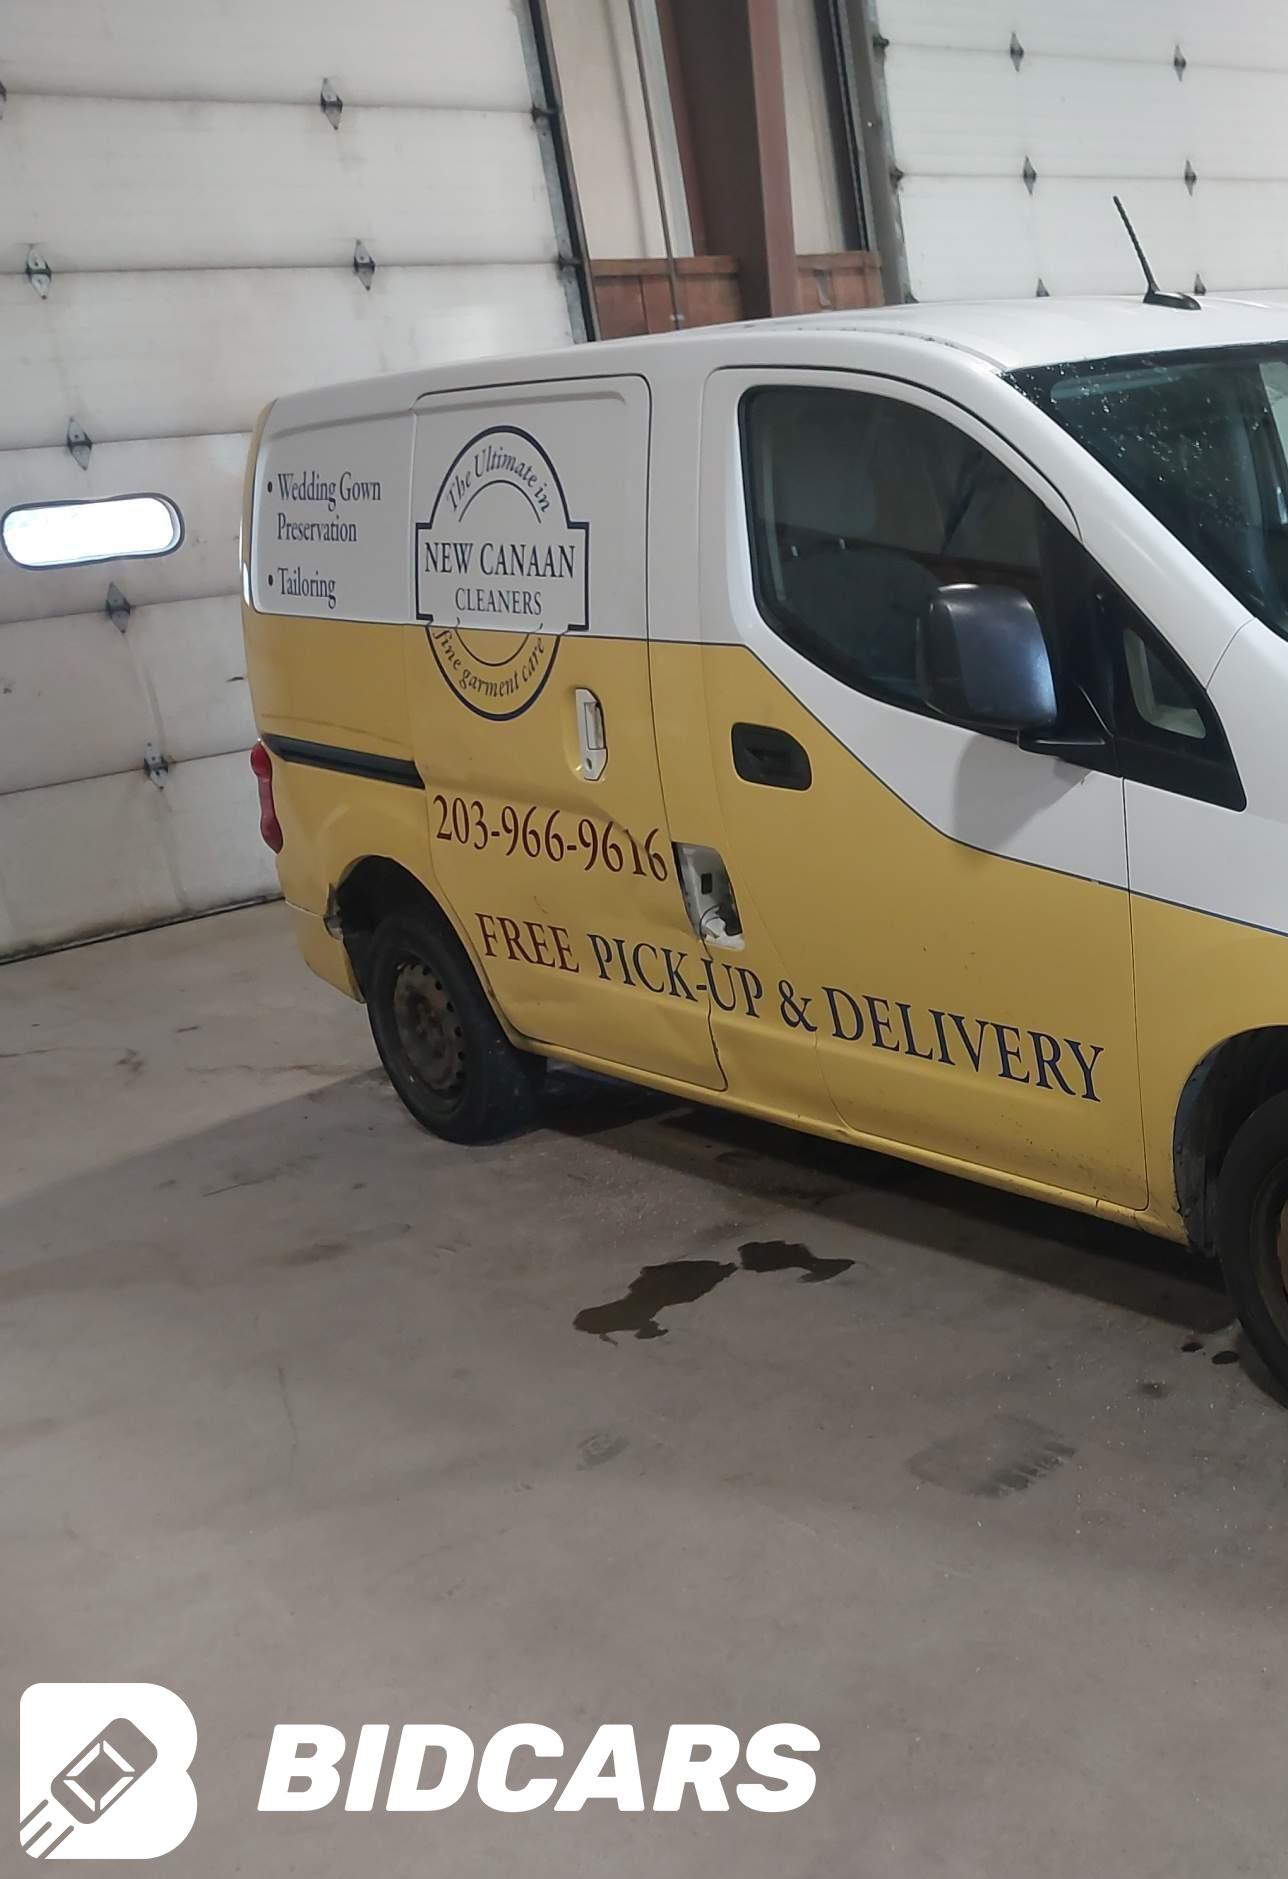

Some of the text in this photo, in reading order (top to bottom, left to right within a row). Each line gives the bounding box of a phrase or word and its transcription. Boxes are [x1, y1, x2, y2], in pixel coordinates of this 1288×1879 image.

[277, 471, 382, 511] Wedding Gown
[446, 445, 550, 512] The Ultimate in
[276, 512, 358, 543] Preservation
[424, 541, 576, 580] NEW CANAAN
[277, 566, 337, 609] Tailoring
[455, 586, 543, 616] CLEANERS
[433, 629, 545, 698] fine garment care
[434, 793, 669, 883] 203-966-9616
[475, 911, 1105, 1102] FREE PICK-UP & DELIVERY
